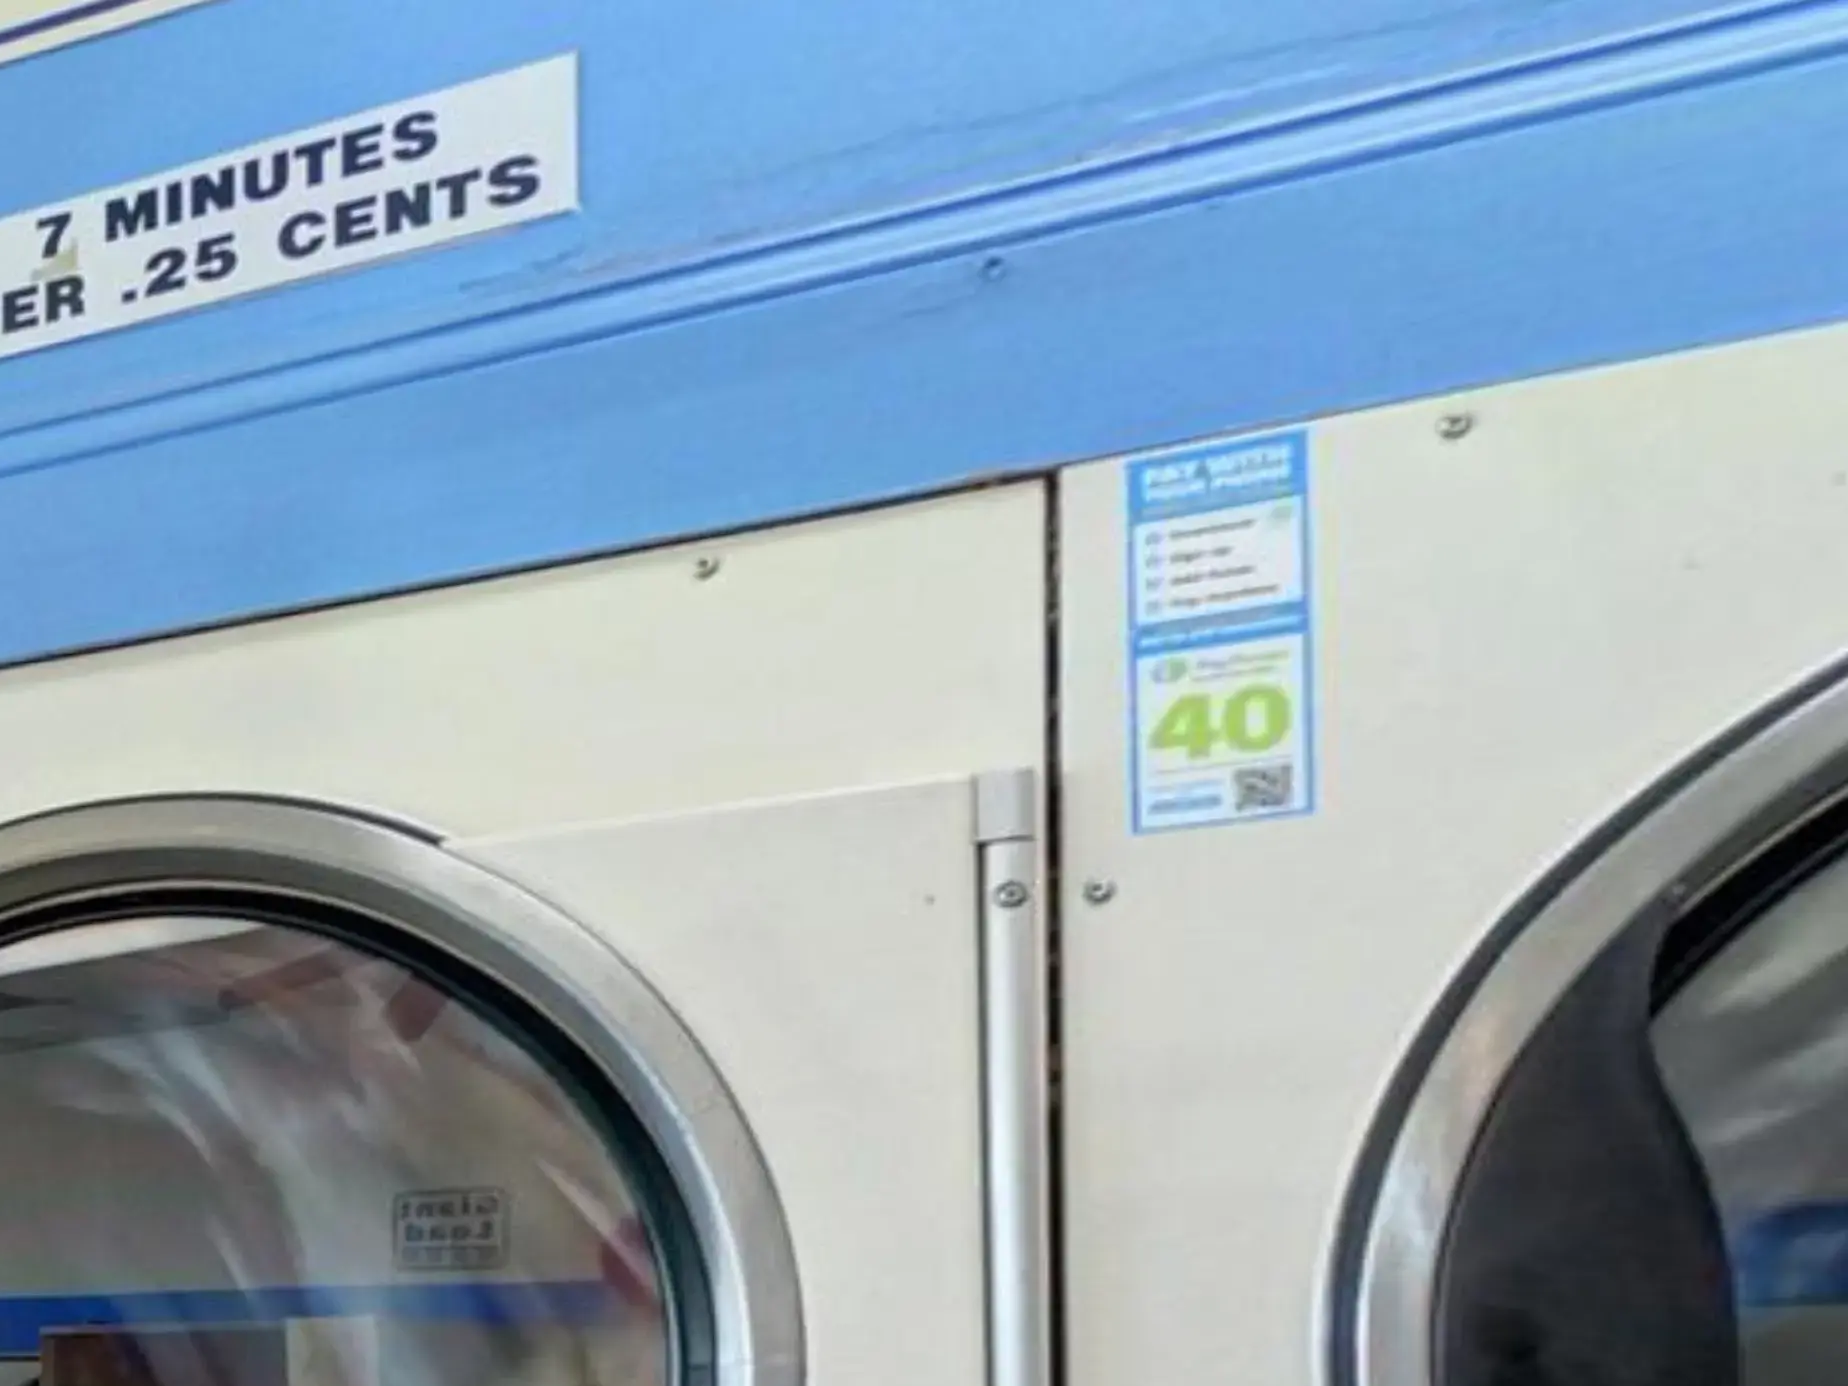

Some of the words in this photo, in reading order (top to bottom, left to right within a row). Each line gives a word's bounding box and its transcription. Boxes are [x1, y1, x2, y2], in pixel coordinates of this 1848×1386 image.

[36, 214, 73, 258] 7
[105, 111, 438, 243] MINUTES
[120, 236, 236, 304] .25
[277, 155, 539, 260] CENTS
[1147, 682, 1293, 760] 40
